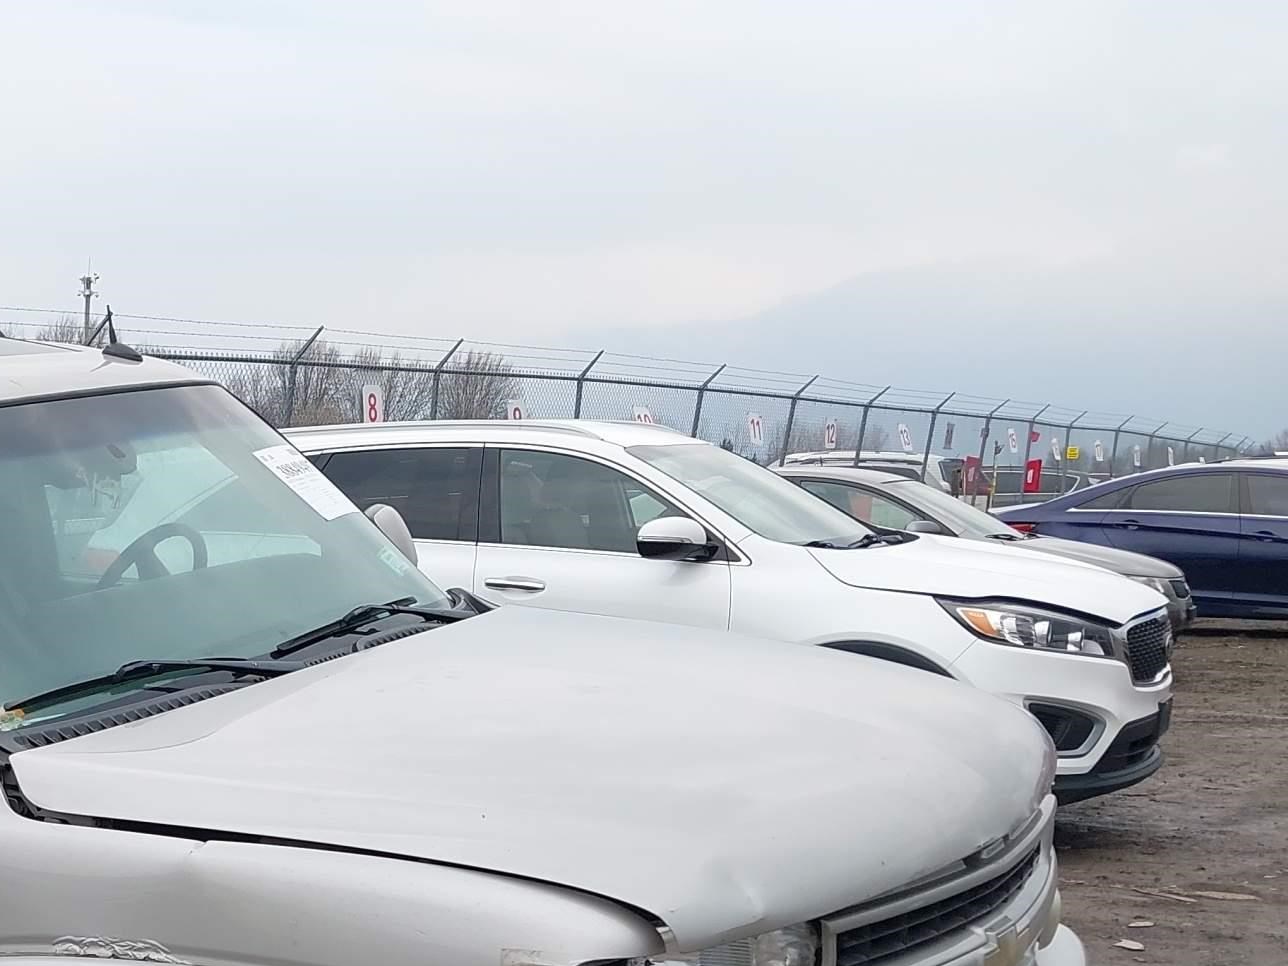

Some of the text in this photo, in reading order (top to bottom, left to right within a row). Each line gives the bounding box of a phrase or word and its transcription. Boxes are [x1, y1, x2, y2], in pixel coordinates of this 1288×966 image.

[368, 392, 378, 423] 8
[750, 418, 762, 441] 11
[826, 423, 835, 444] 12
